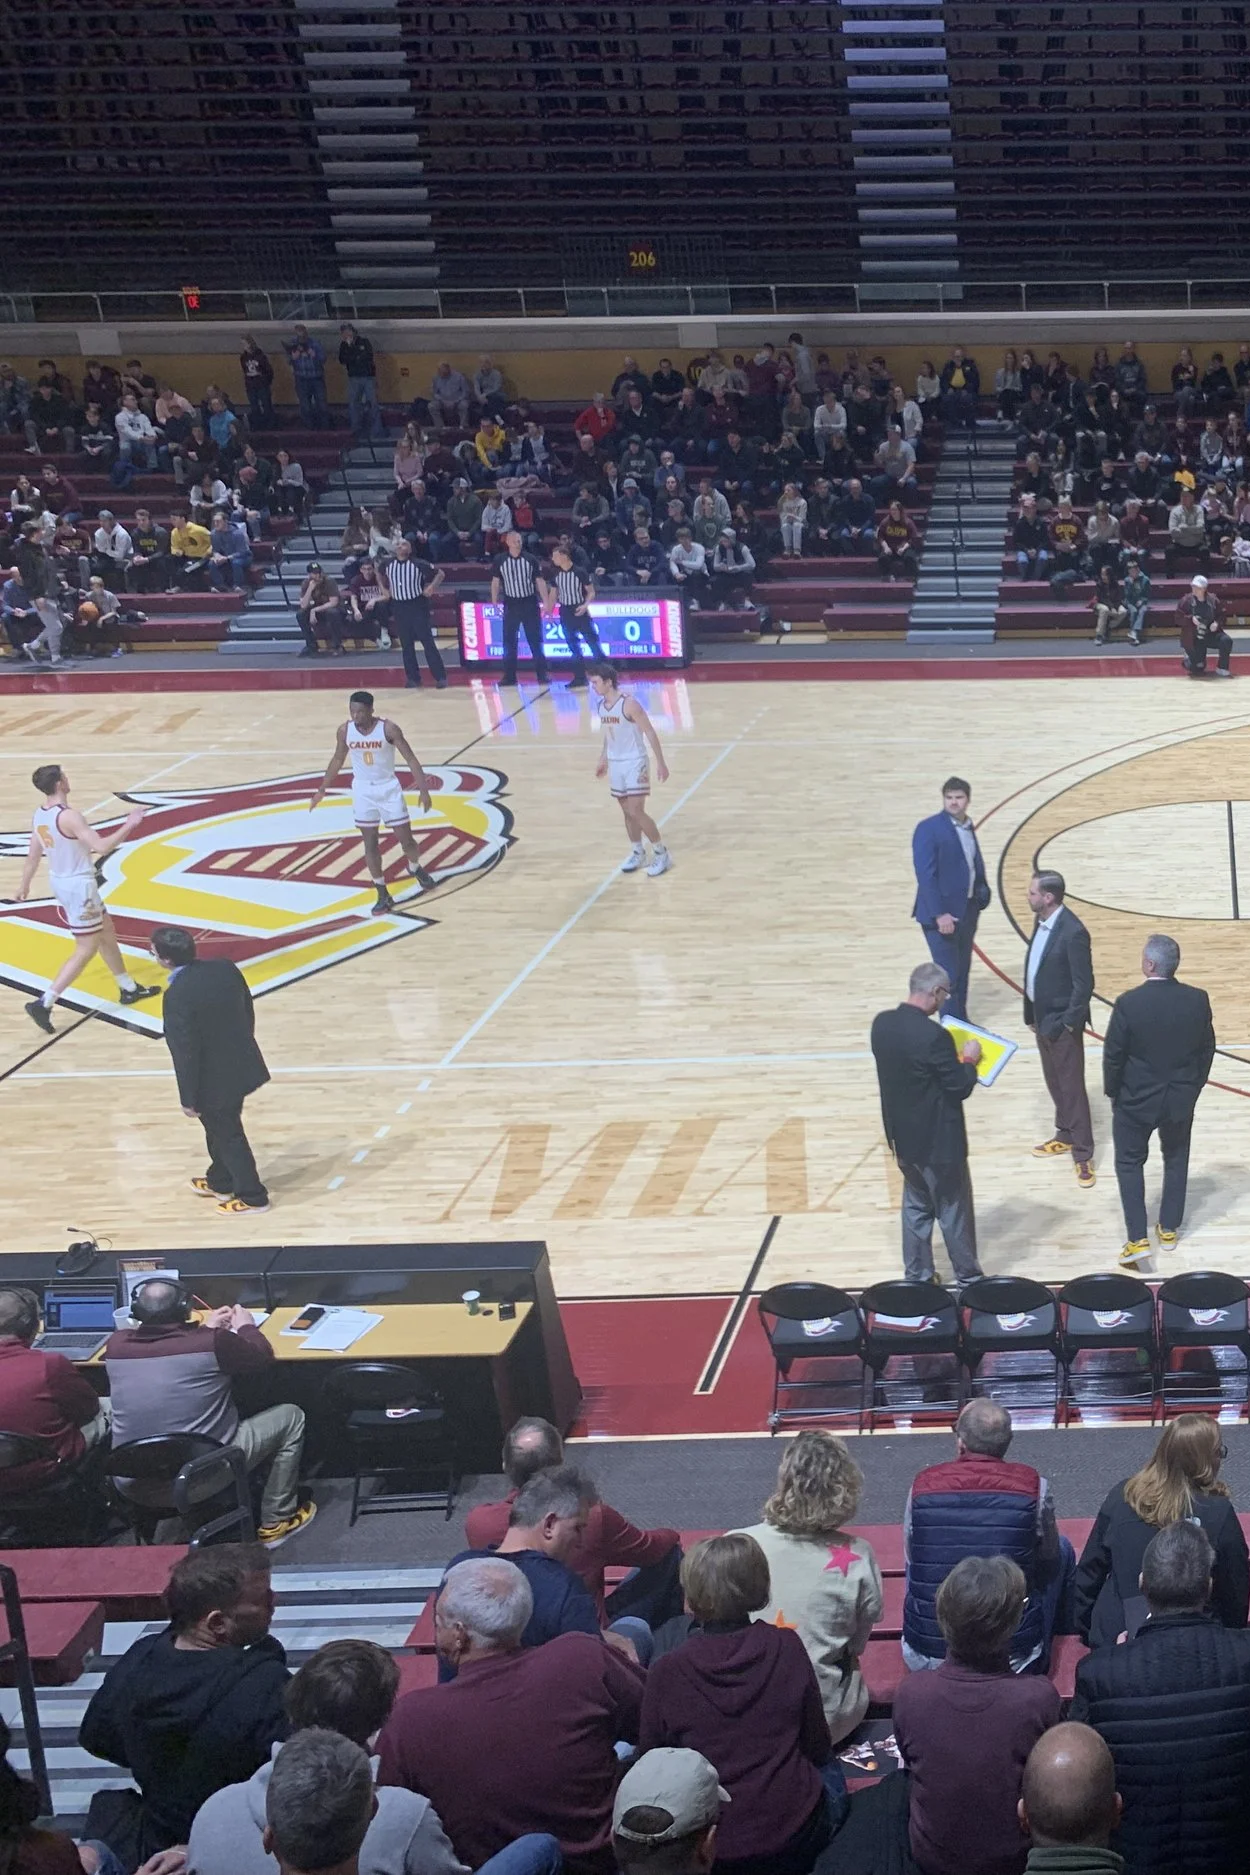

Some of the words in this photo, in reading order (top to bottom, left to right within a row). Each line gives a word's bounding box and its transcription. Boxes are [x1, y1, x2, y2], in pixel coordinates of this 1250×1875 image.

[629, 252, 656, 267] 206
[606, 606, 657, 615] BULLDOGS
[463, 602, 478, 649] CALVIN
[624, 620, 640, 642] 0
[349, 741, 382, 749] CALVIN
[363, 751, 373, 767] 0
